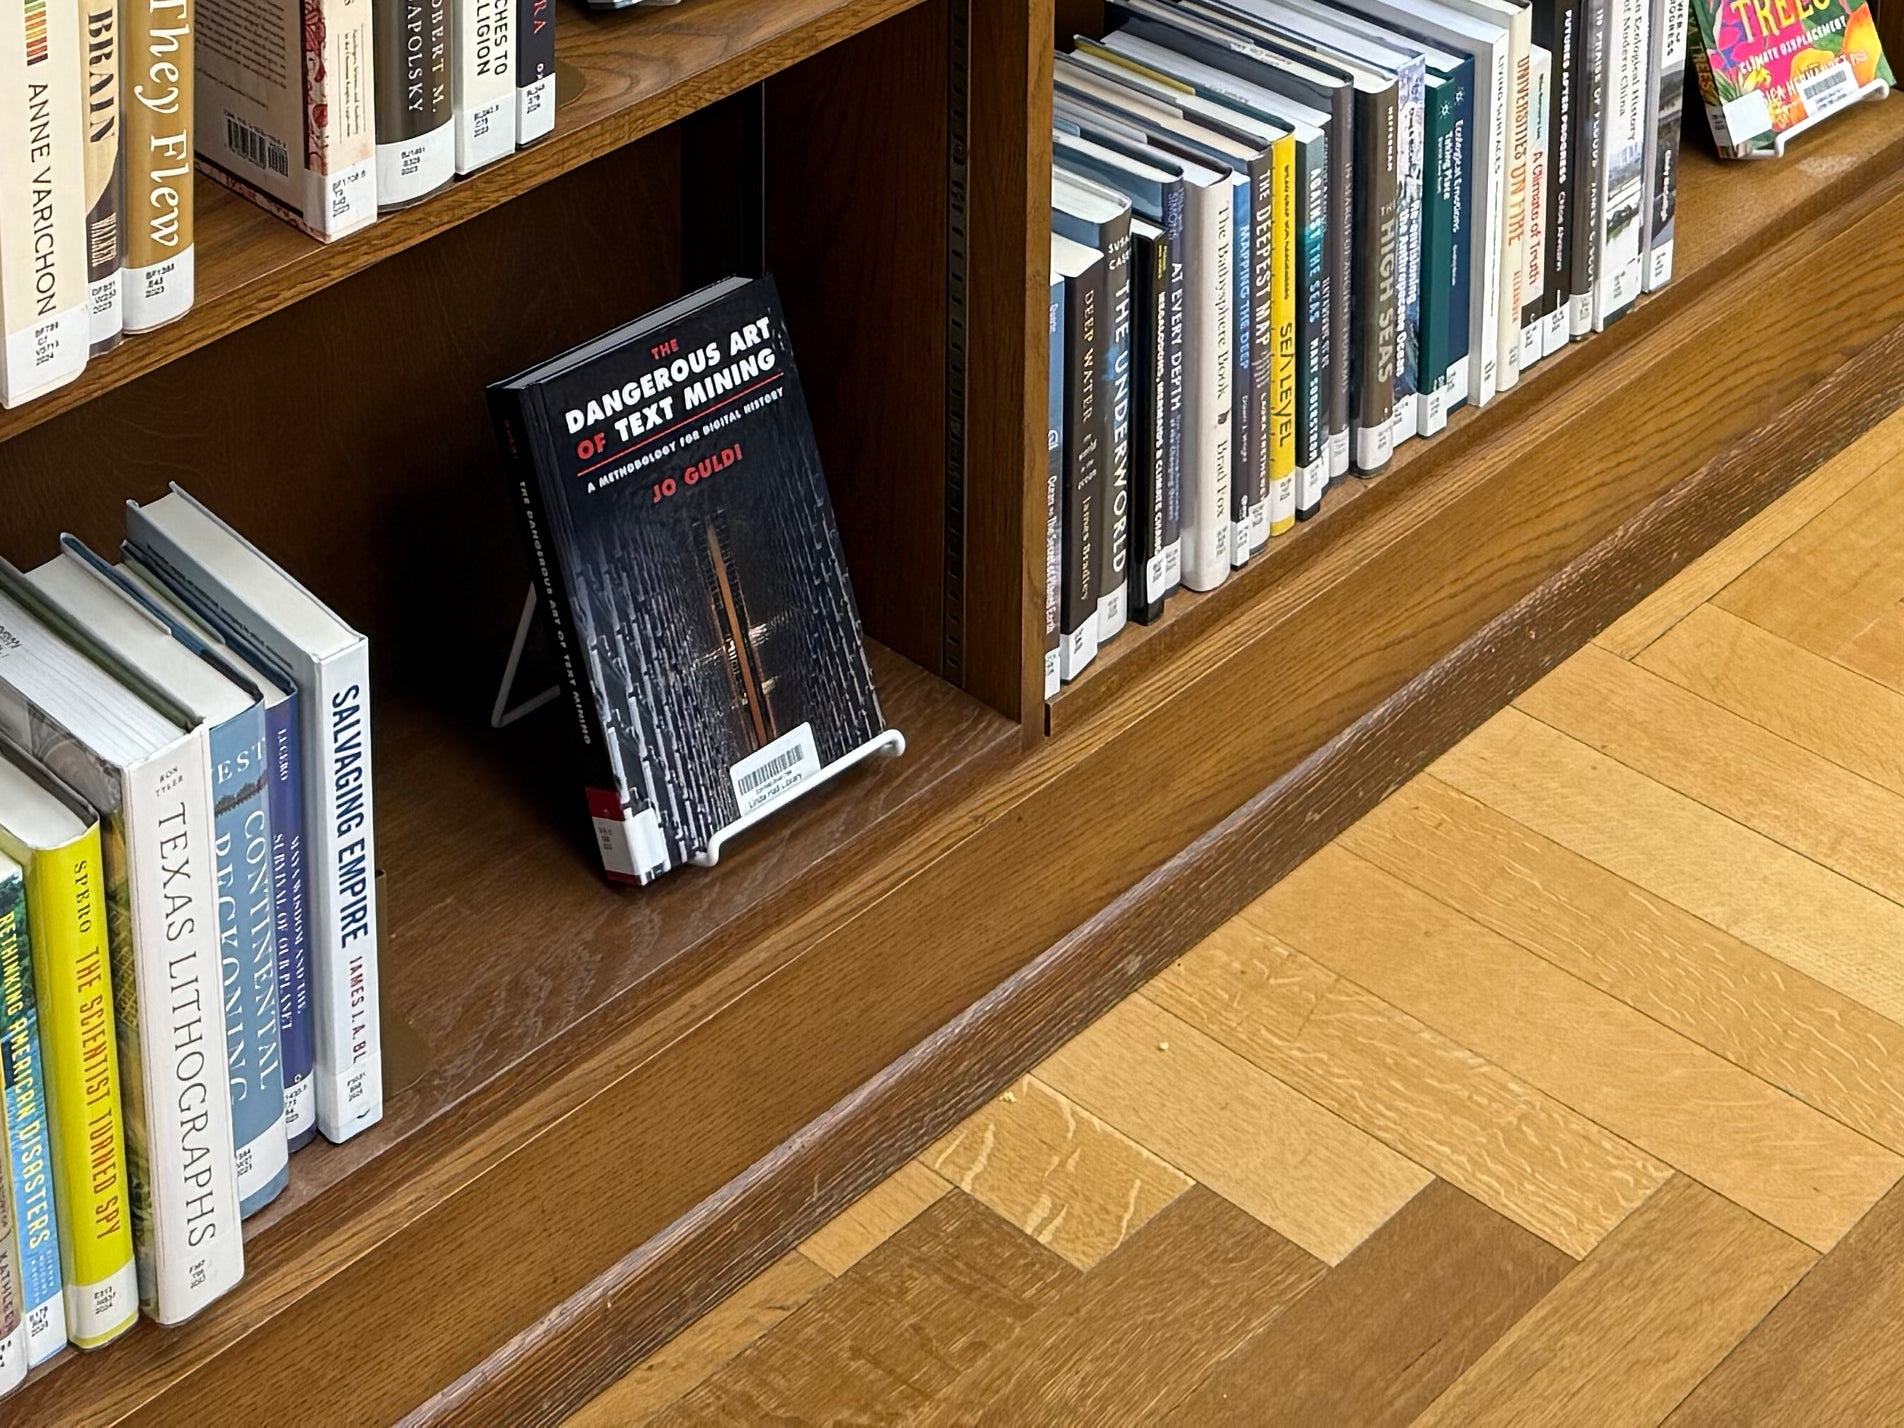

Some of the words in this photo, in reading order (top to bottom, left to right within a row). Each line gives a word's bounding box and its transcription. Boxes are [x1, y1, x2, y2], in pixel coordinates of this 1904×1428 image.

[1739, 43, 1780, 76] CLIMATE
[149, 133, 190, 249] Flew
[651, 338, 680, 360] THE
[1115, 279, 1131, 344] THE
[565, 339, 722, 434] DANGEROUS
[729, 315, 771, 354] ART
[576, 432, 607, 461] OF
[614, 400, 677, 444] TEXT
[684, 347, 777, 411] MINING
[587, 481, 596, 494] A
[599, 441, 676, 491] METHODOLOGY
[679, 428, 700, 450] FOR
[702, 407, 742, 439] DIGITAL
[744, 387, 785, 420] HISTORY
[651, 476, 677, 504] JO
[684, 443, 743, 486] GULDI
[1112, 349, 1129, 573] UNDERWORLD
[331, 683, 363, 838] SALVAGING
[157, 803, 192, 942] TEXAS
[339, 841, 371, 950] EMPIRE
[168, 951, 217, 1250] LITHOGRAPHS
